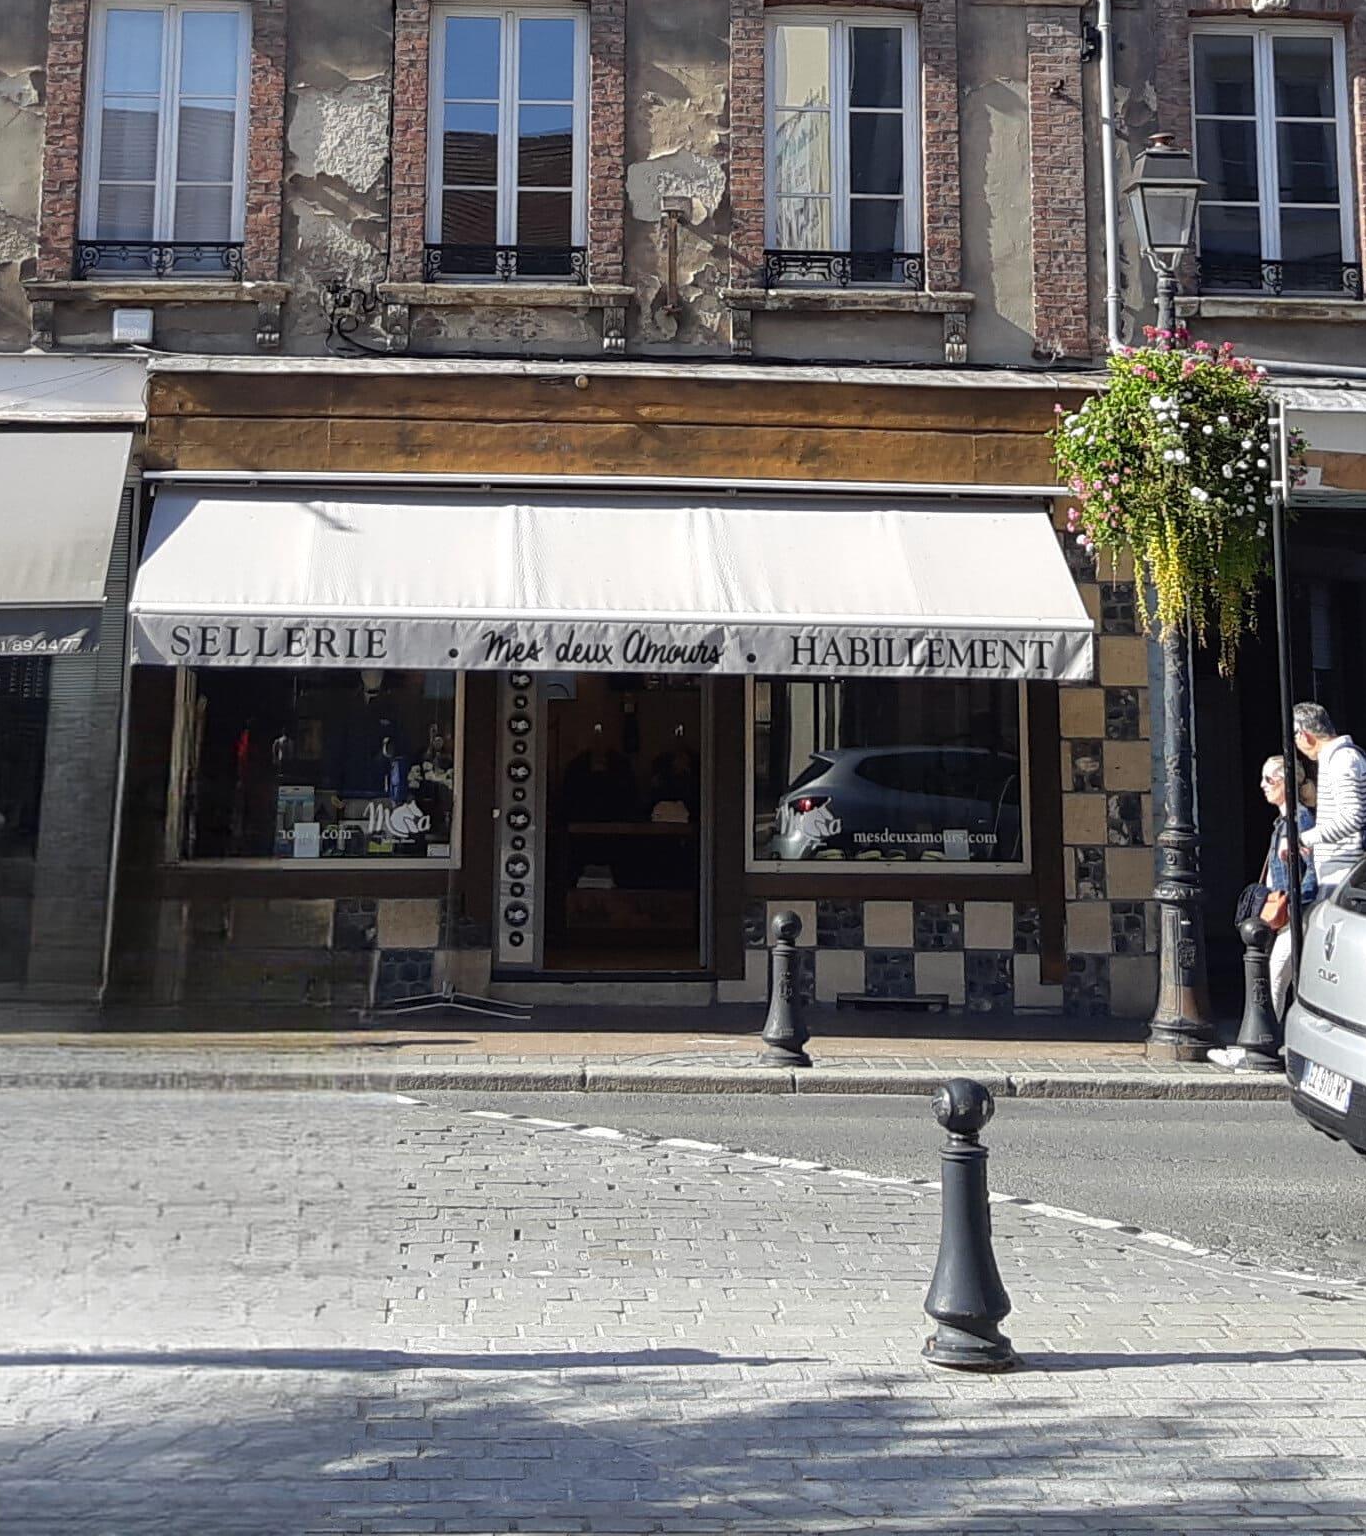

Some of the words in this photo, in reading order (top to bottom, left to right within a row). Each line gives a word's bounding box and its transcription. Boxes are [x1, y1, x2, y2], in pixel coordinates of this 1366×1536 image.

[12, 639, 33, 652] 89
[36, 639, 58, 651] 44
[170, 625, 388, 658] SELLERIE
[482, 629, 543, 662] Mes
[556, 629, 614, 665] deux
[622, 629, 724, 665] Amours
[789, 634, 1053, 670] HABILLEMENT
